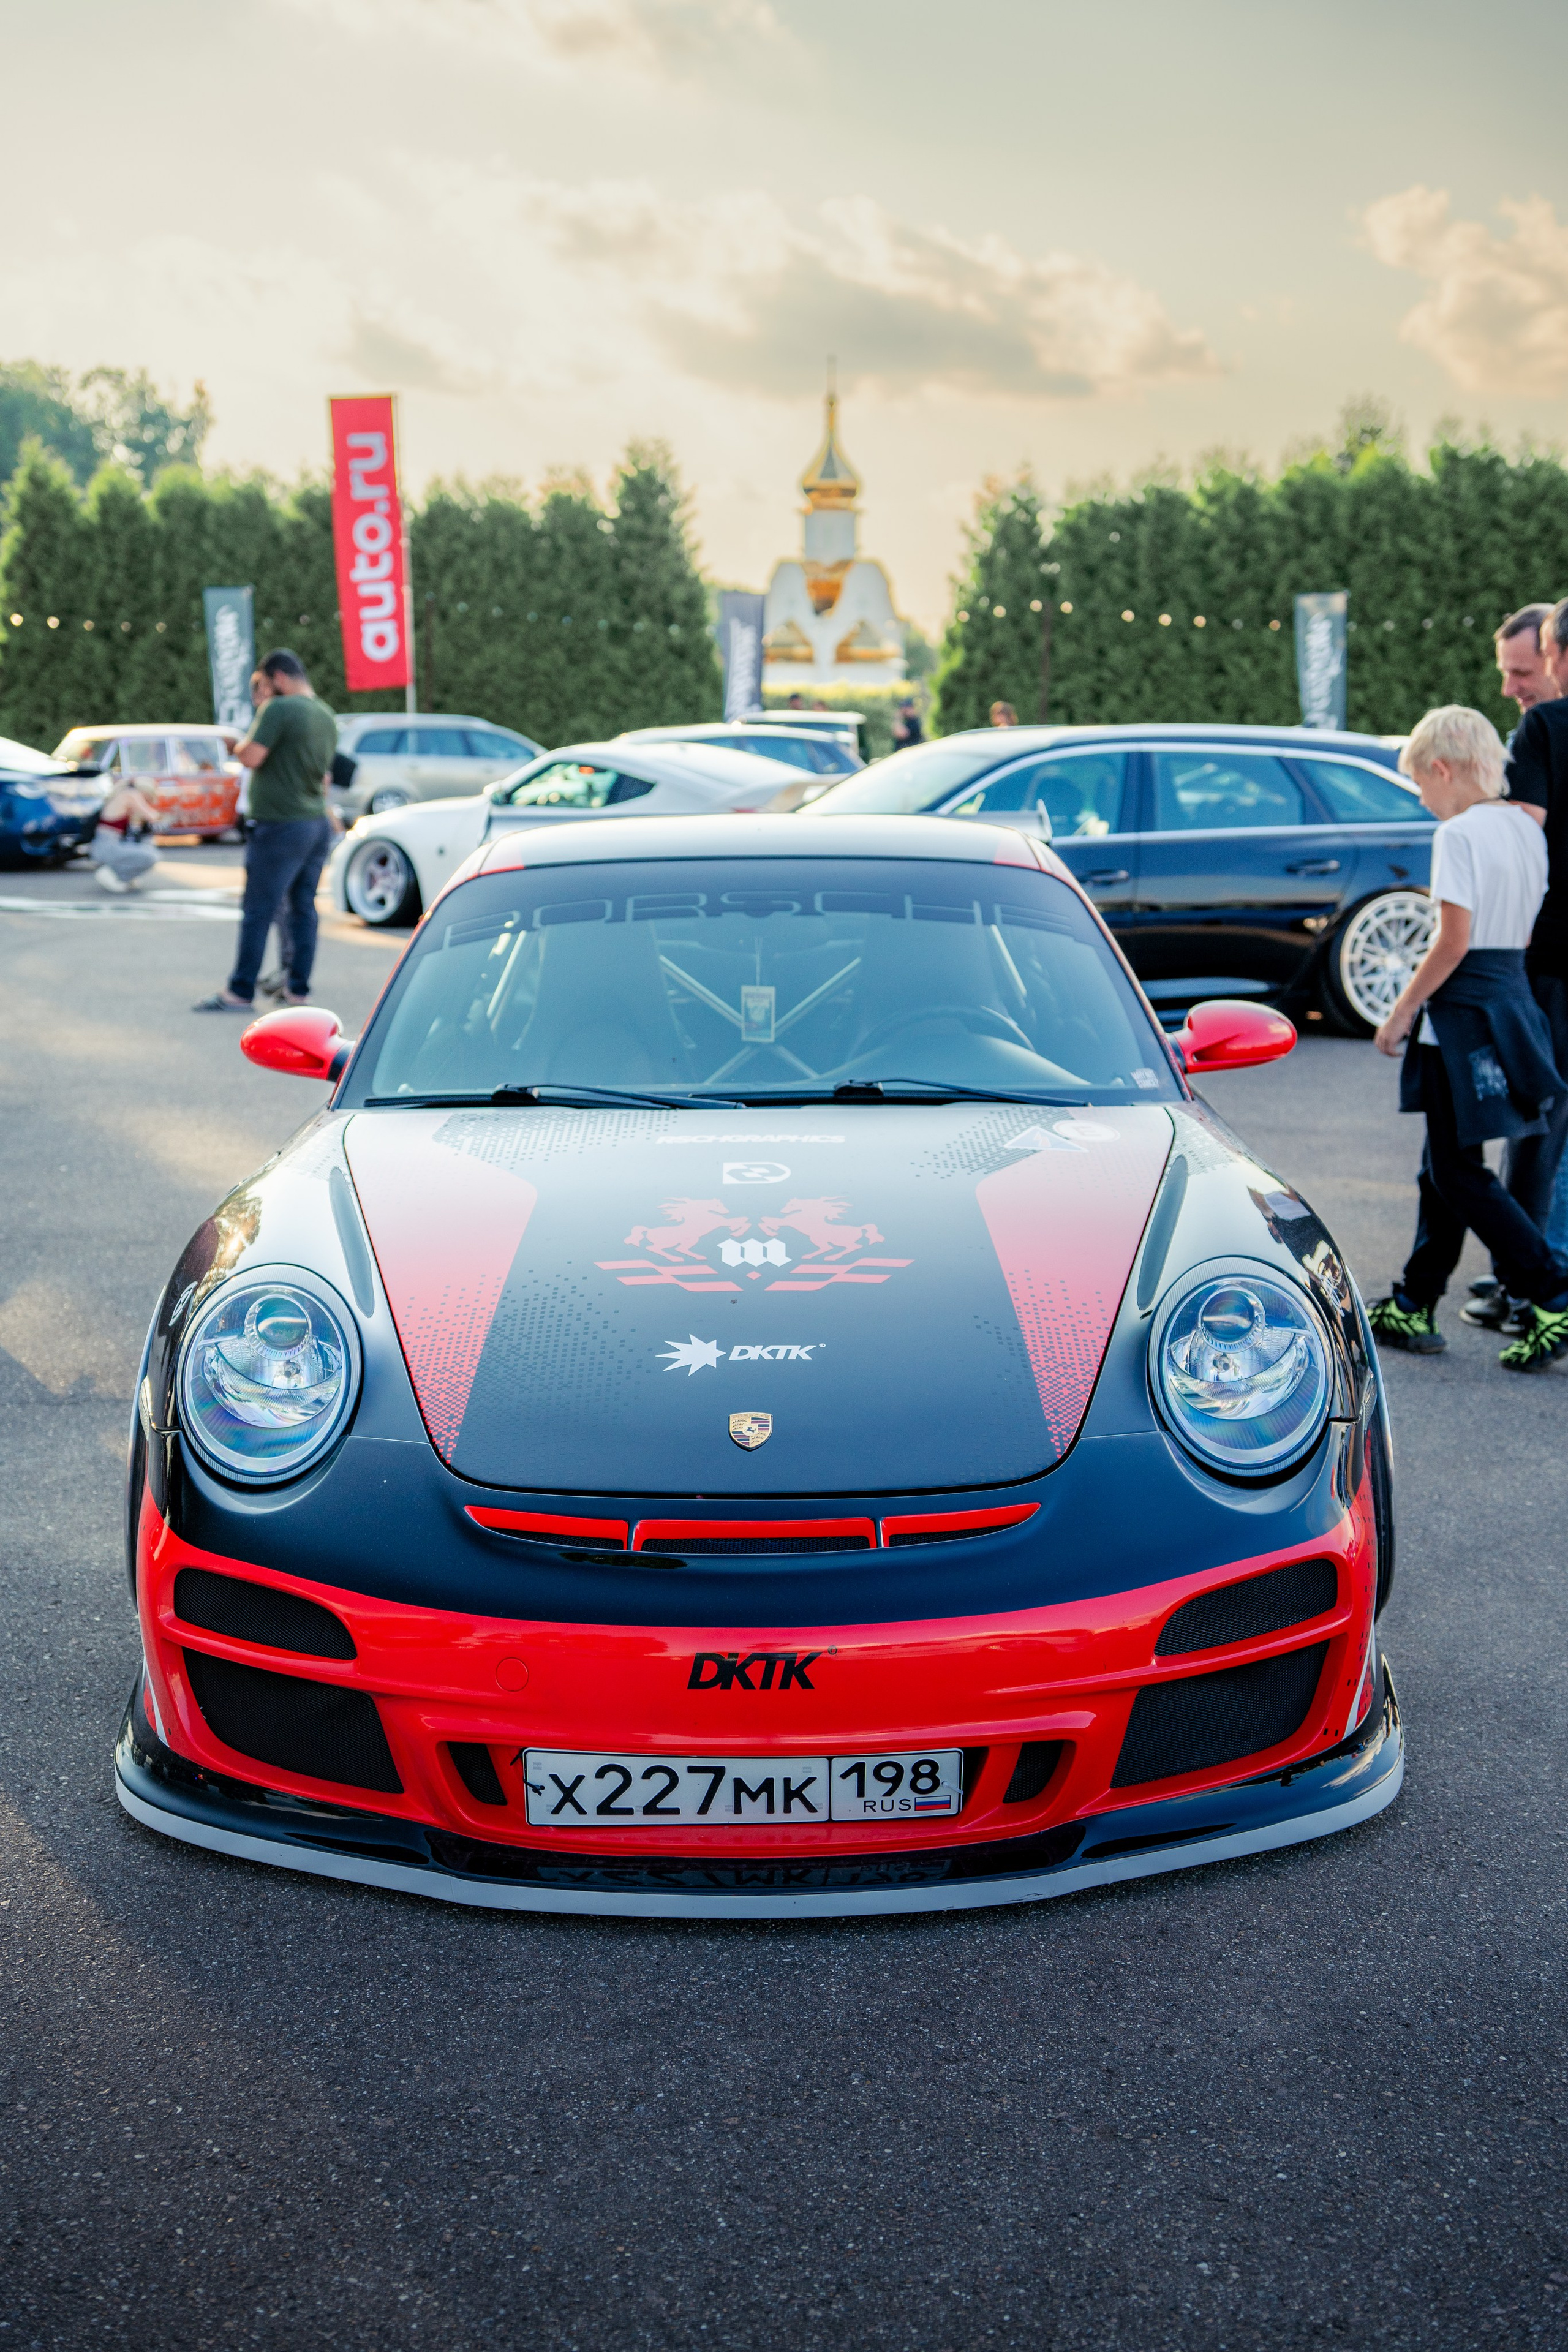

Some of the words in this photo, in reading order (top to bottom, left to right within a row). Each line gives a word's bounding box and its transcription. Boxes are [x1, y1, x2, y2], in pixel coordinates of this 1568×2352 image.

[346, 431, 400, 663] auto.ru
[839, 1758, 941, 1798] 198
[863, 1798, 912, 1813] RUS
